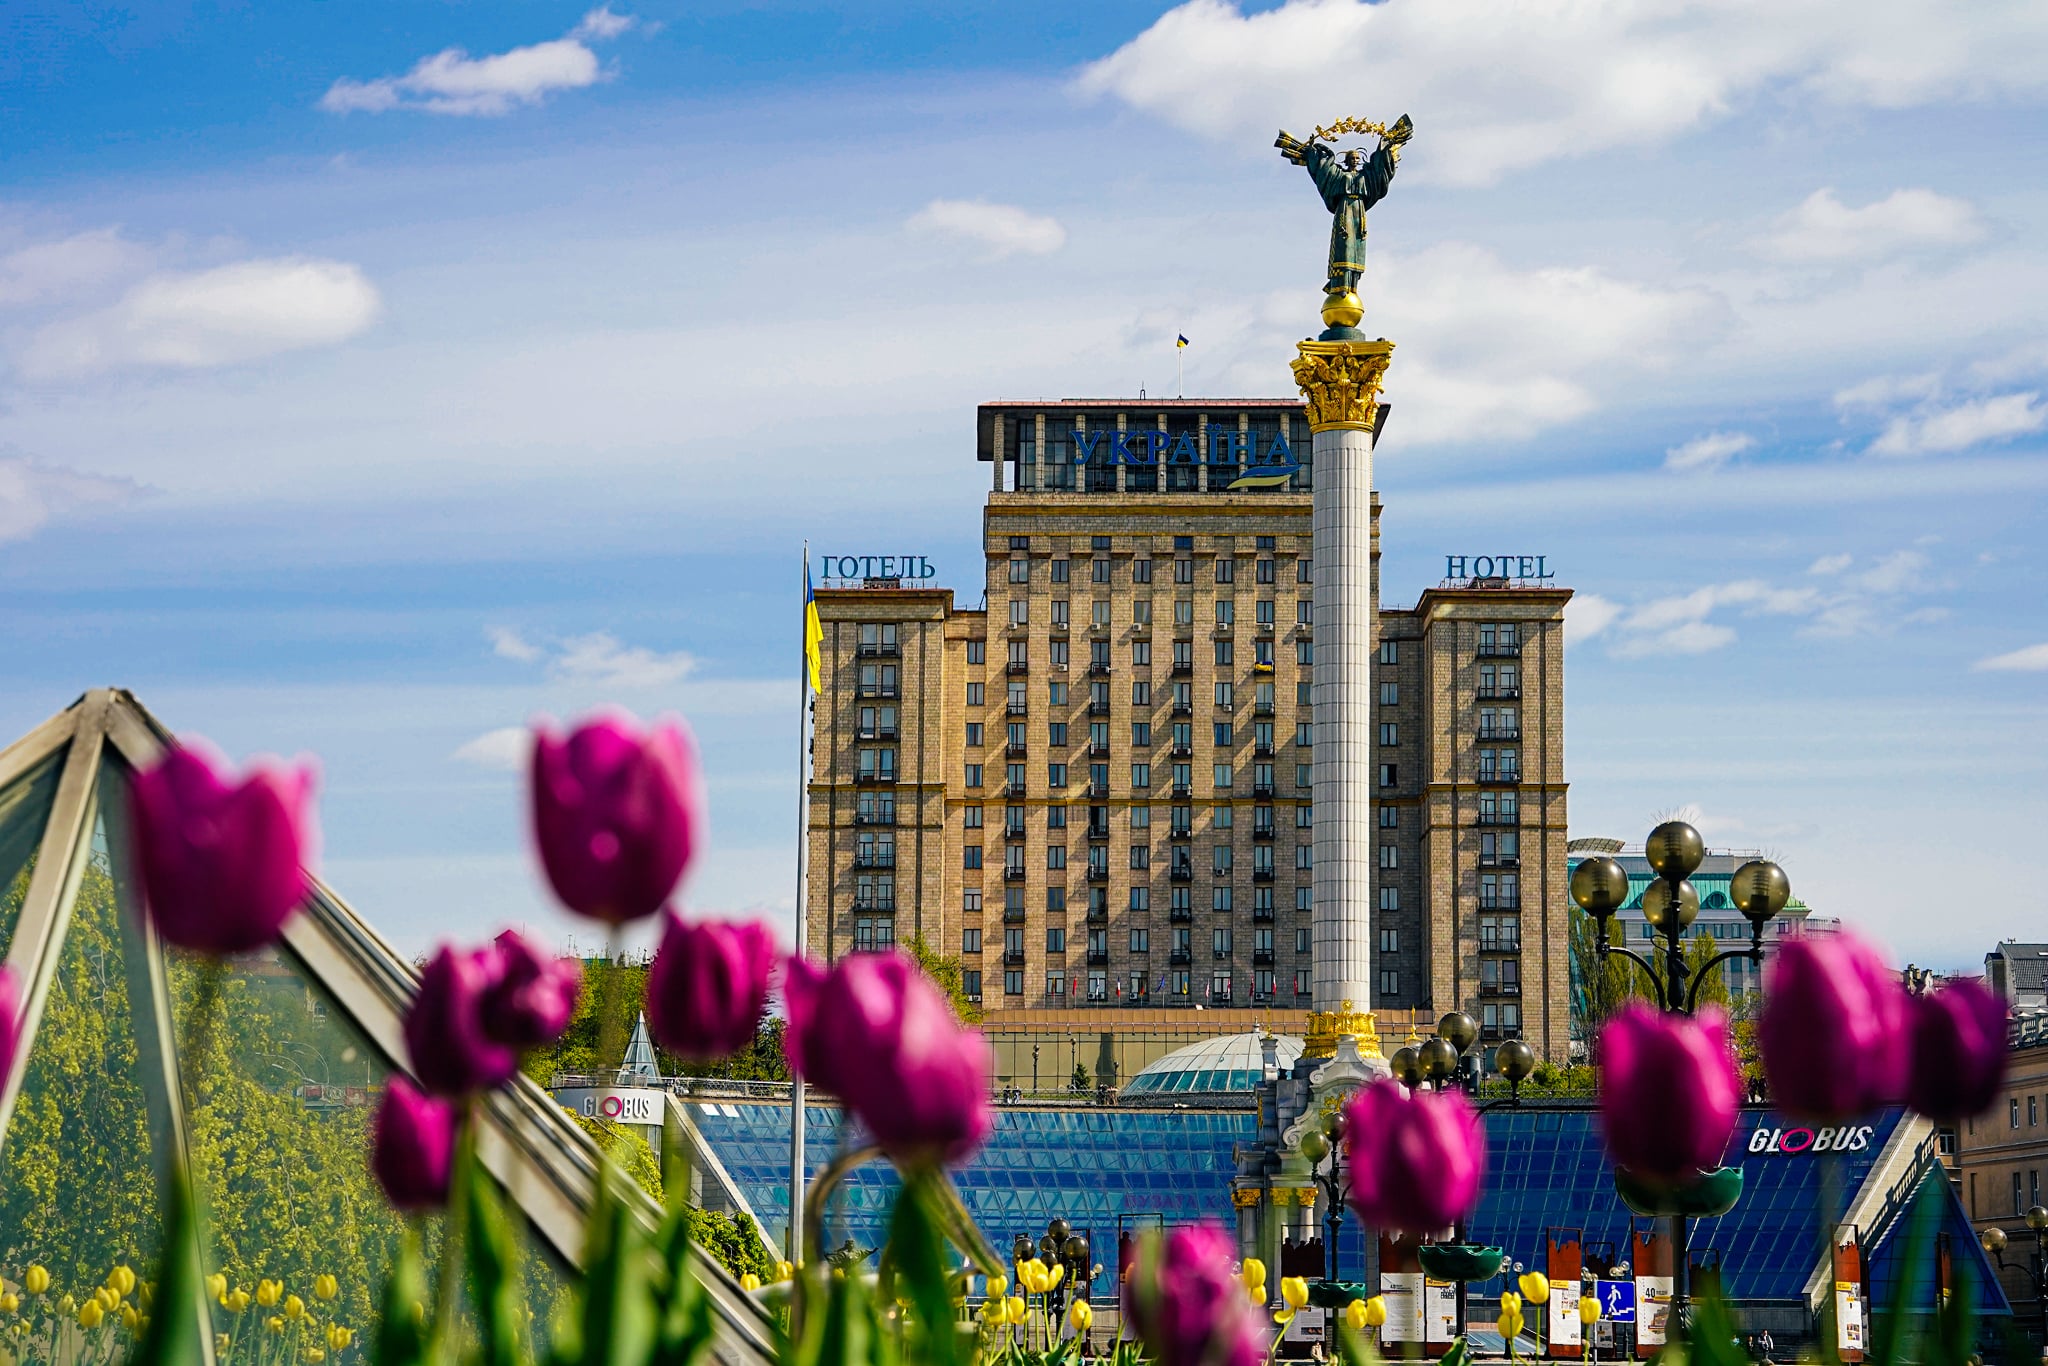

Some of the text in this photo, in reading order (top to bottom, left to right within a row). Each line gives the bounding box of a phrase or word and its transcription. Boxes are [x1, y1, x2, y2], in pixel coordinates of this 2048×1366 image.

[1070, 423, 1299, 465] УКРАЇНА
[821, 556, 936, 579] ГОТЕЛЬ
[1445, 555, 1555, 579] HOTEL
[583, 1096, 651, 1119] GLOBUS
[1748, 1126, 1874, 1153] GLOBUS
[1645, 1287, 1656, 1298] 40
